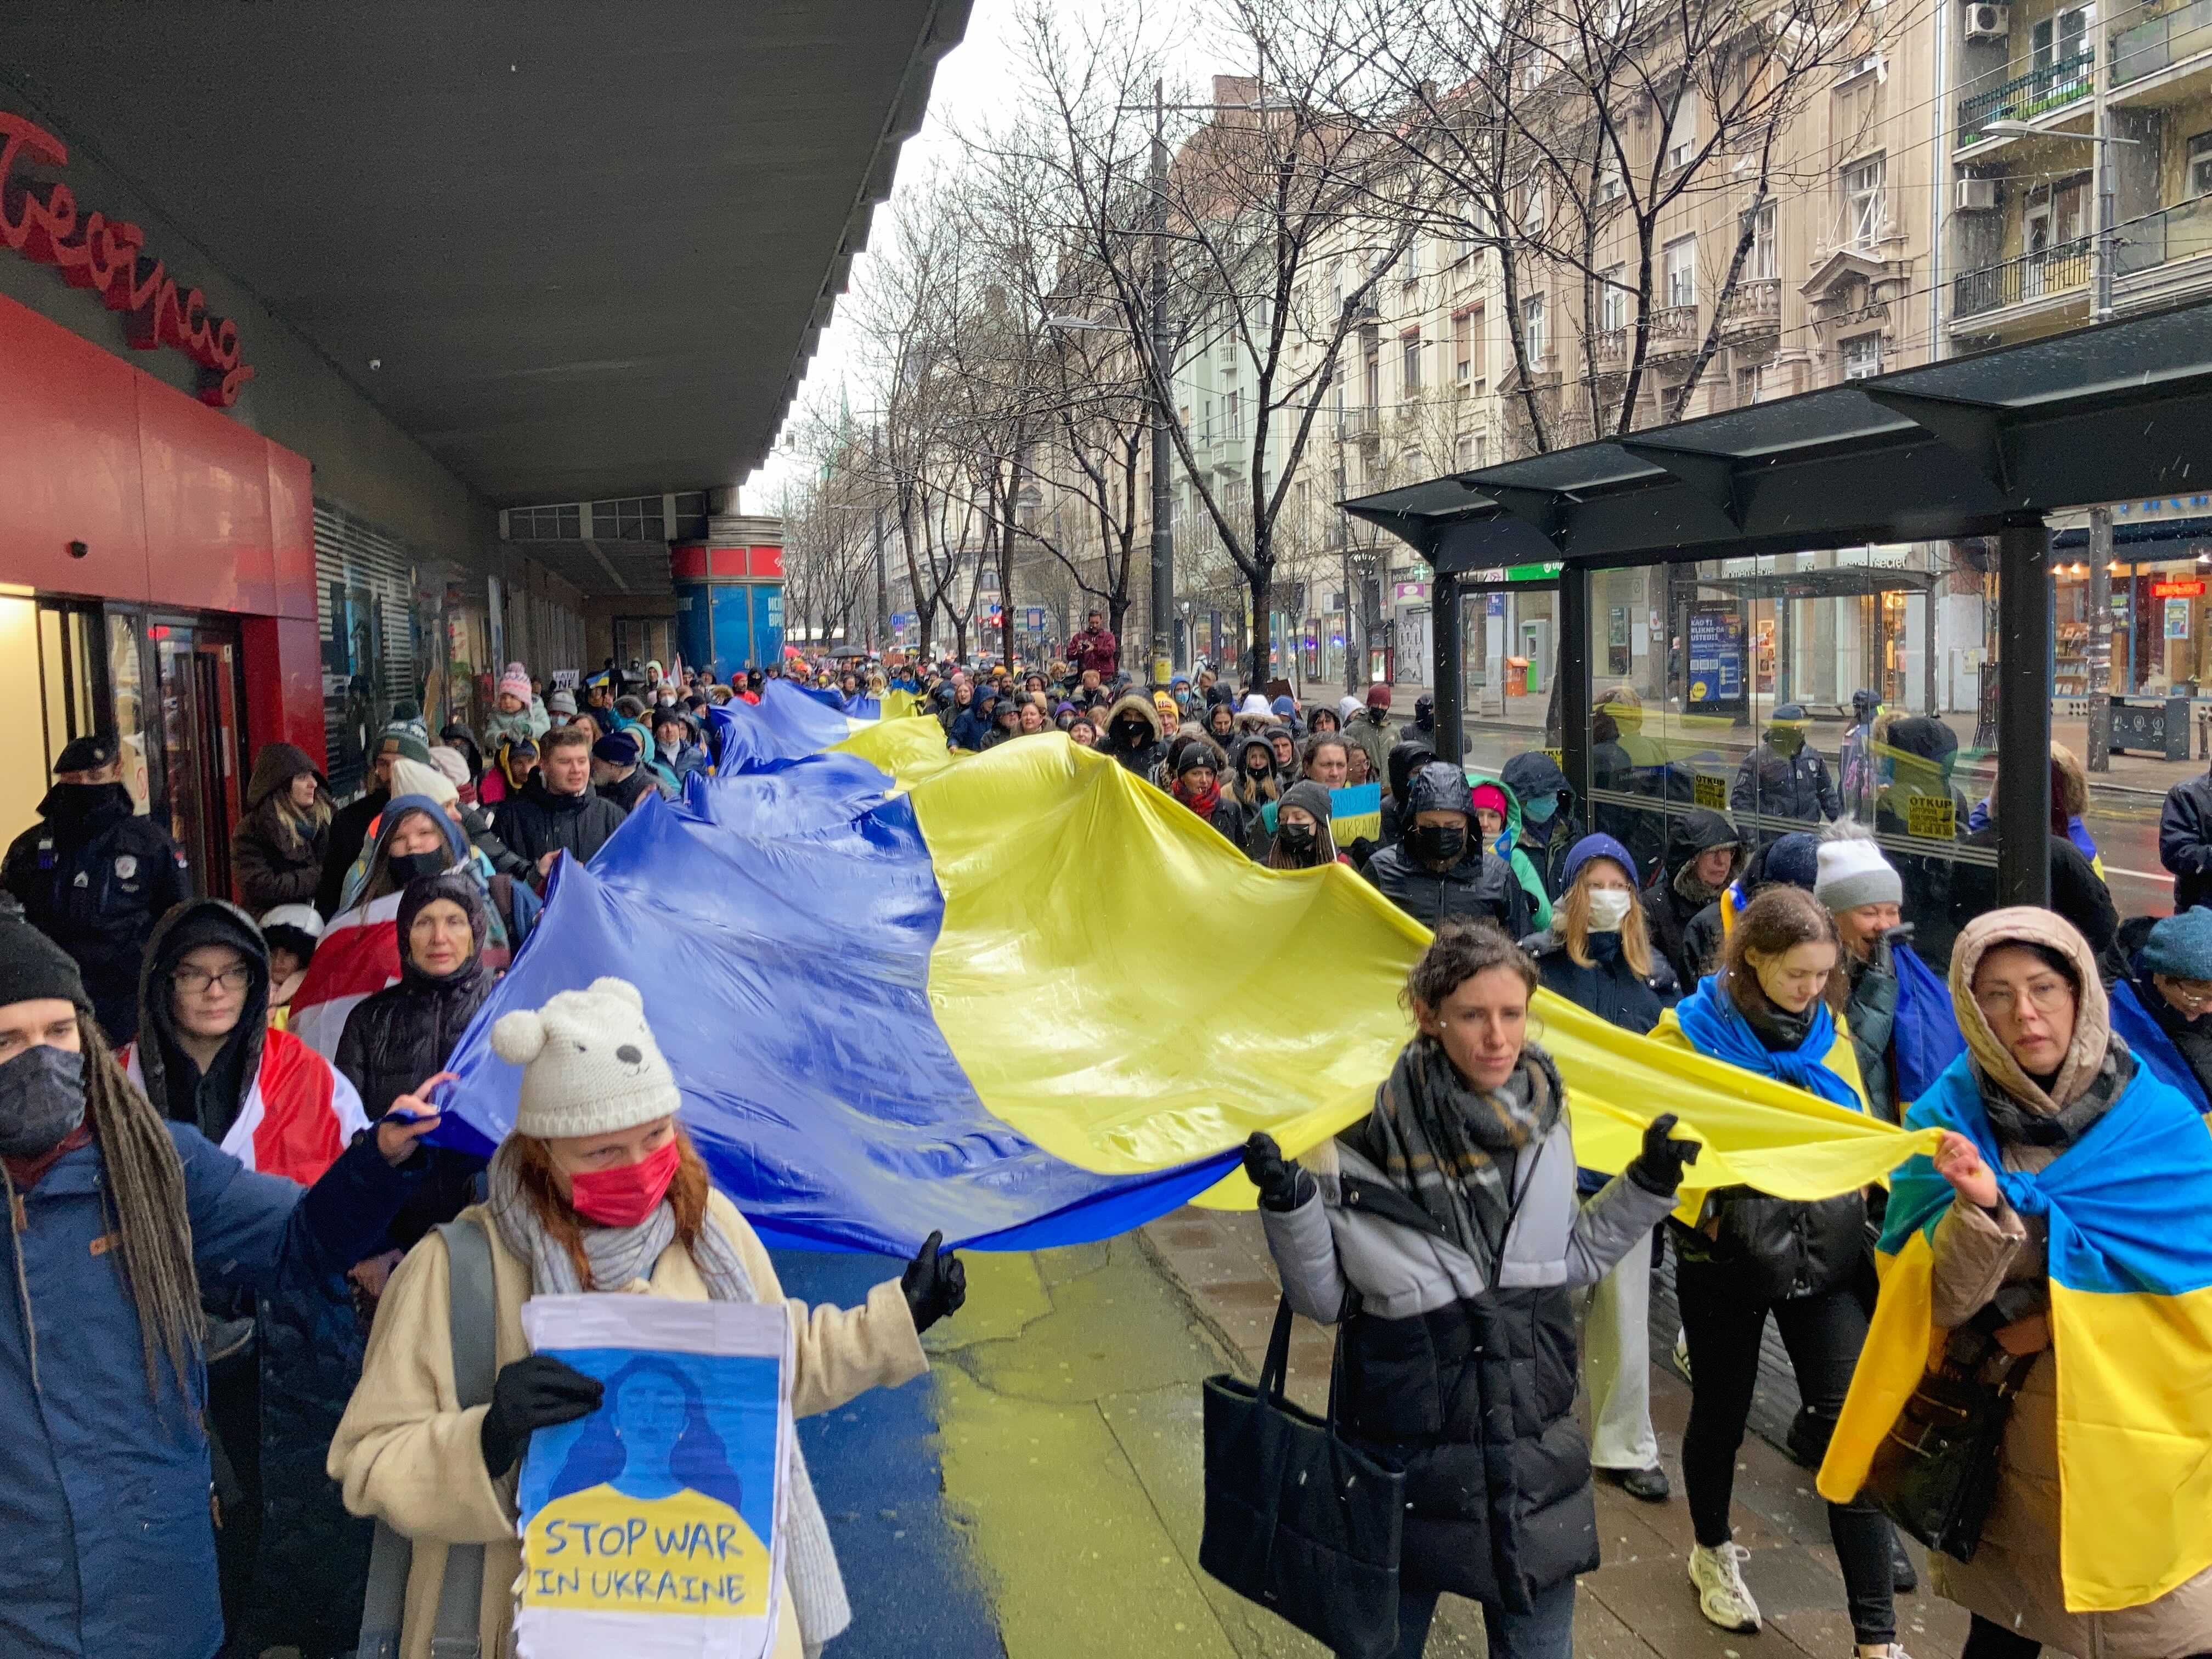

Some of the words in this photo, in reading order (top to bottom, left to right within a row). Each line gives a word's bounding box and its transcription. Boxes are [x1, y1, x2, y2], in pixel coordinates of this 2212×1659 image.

[1696, 775, 1725, 786] OTKUP
[1910, 796, 1951, 809] OTKUP
[545, 1517, 648, 1558] STOP
[654, 1522, 743, 1561] WAR
[534, 1567, 580, 1596] IN
[591, 1569, 746, 1606] UKRAINE
